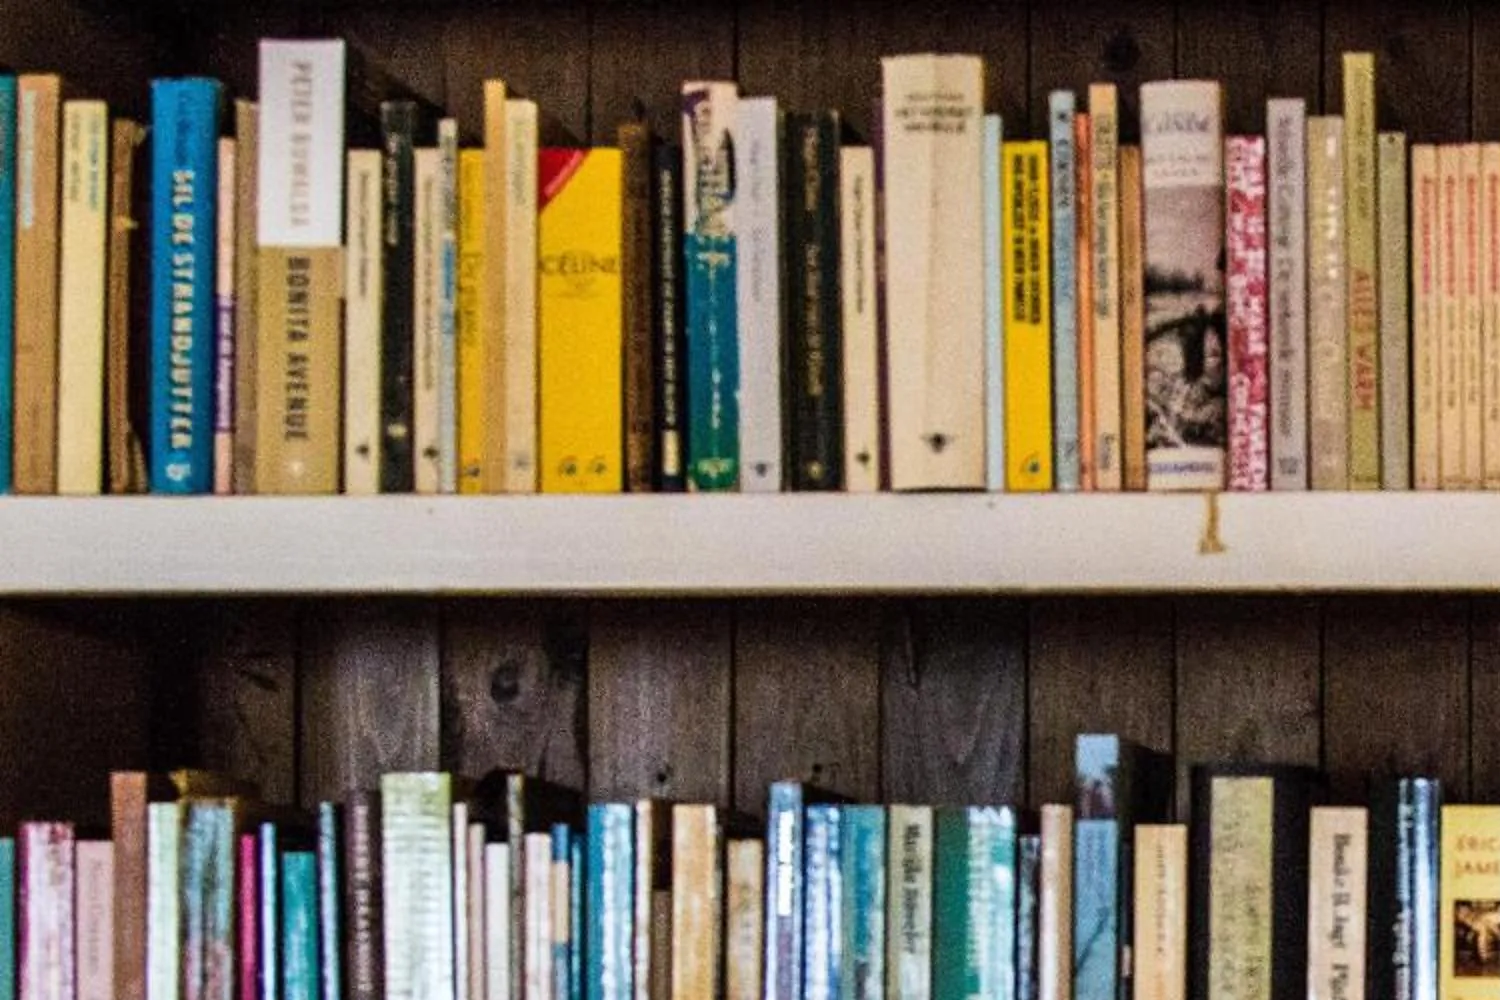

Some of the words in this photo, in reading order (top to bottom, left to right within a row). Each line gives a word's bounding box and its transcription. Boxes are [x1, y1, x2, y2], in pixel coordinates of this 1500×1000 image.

[287, 258, 310, 343] BONITA
[171, 254, 196, 450] STRANDJUTTER
[286, 353, 309, 443] AVENUE
